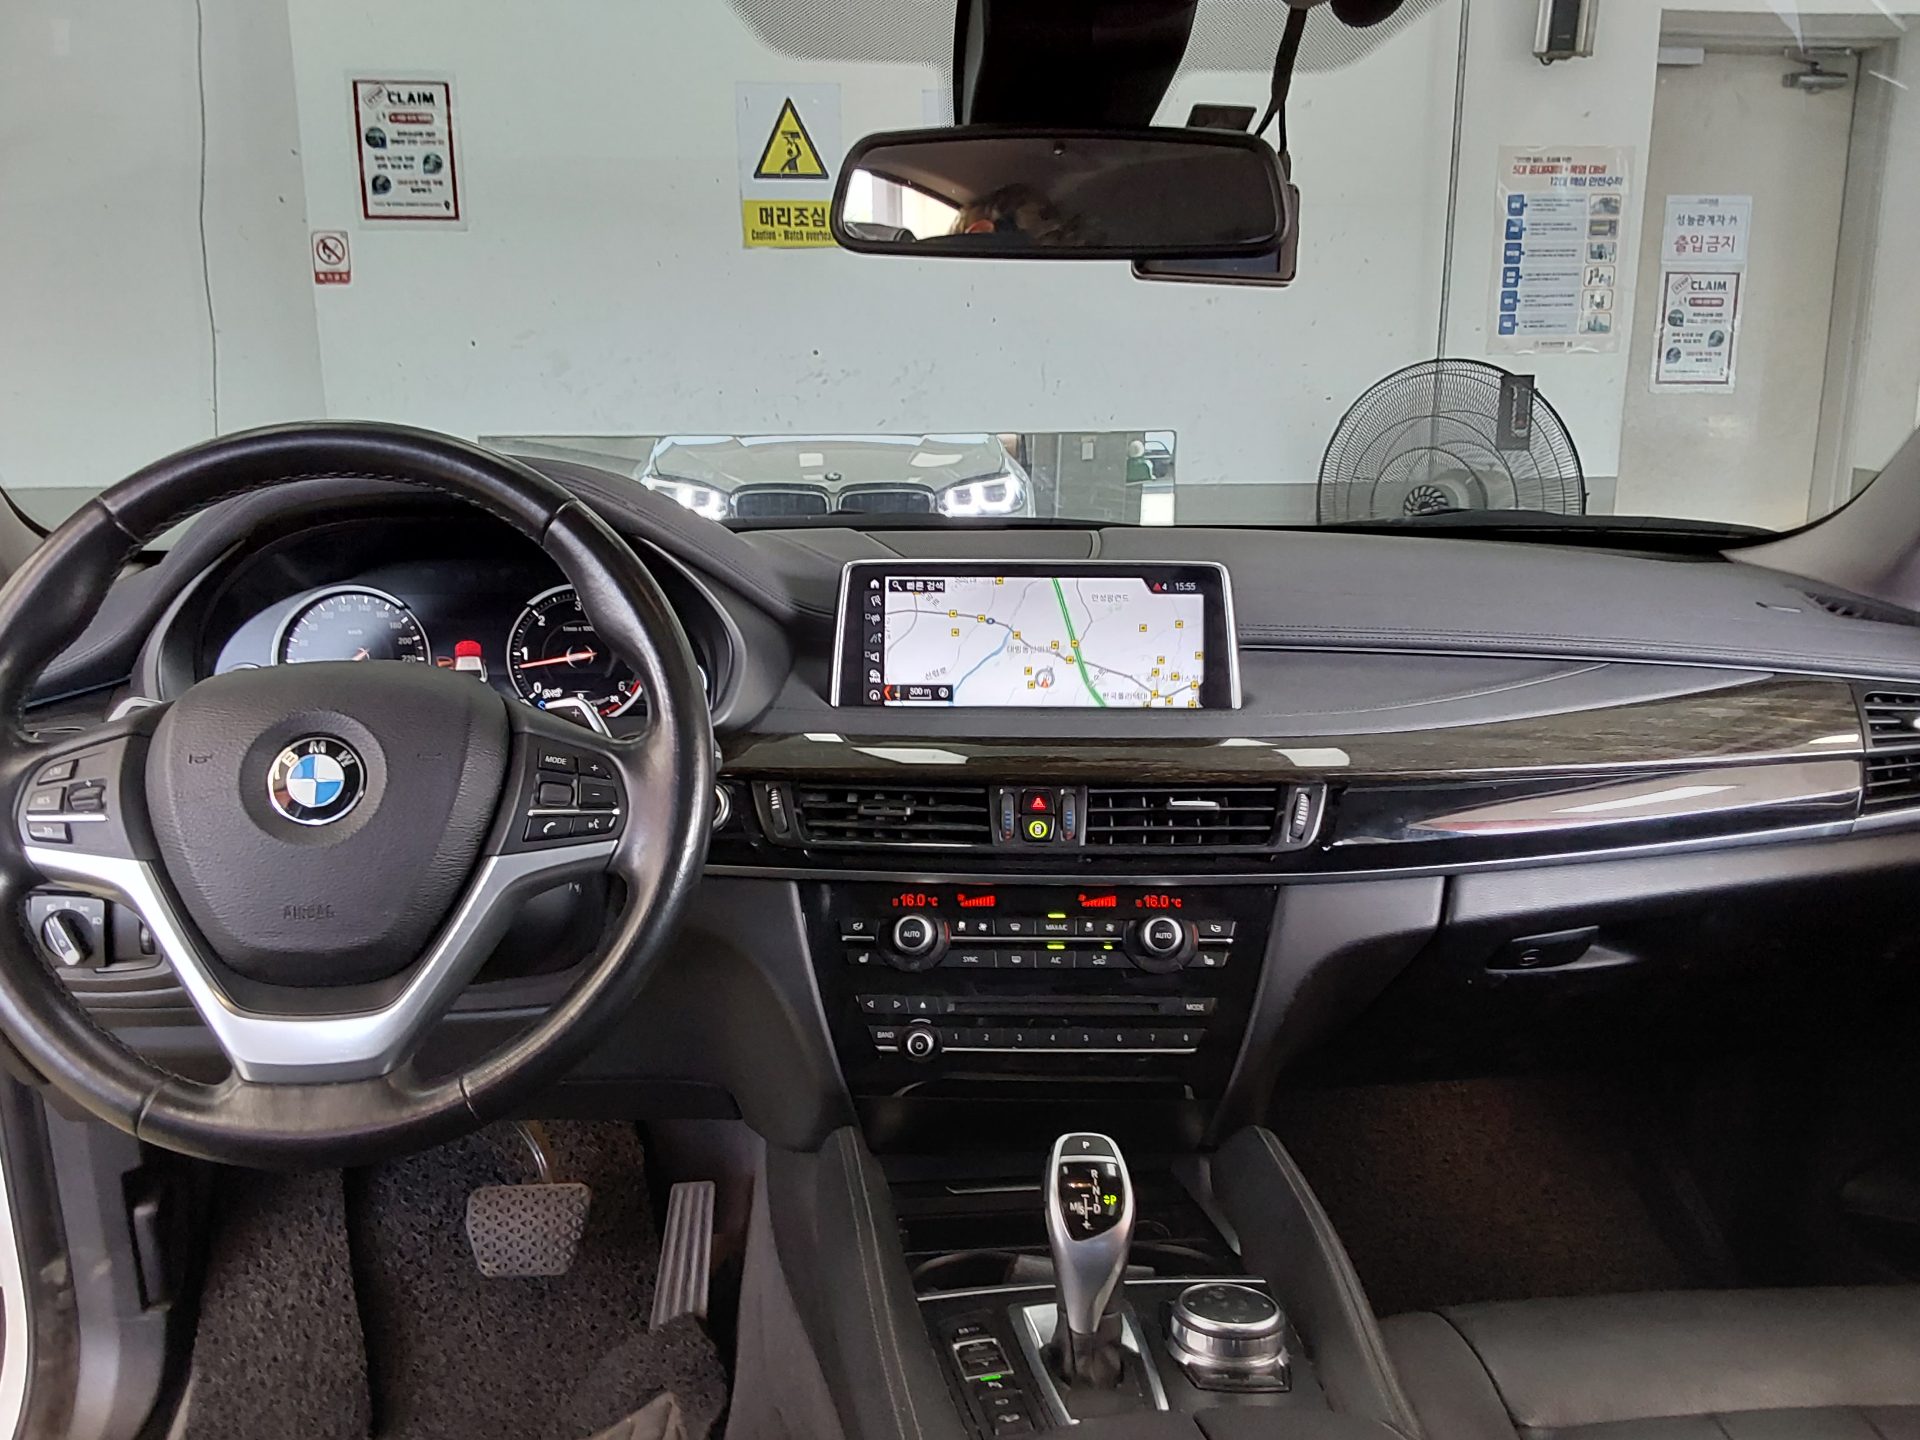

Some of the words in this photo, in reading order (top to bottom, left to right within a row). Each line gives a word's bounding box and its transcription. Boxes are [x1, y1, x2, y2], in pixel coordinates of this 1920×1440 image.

[387, 91, 435, 106] CLAIM
[1588, 176, 1623, 187] 안전수칙
[759, 206, 826, 228] 머리조심
[751, 229, 776, 241] Caution
[783, 229, 804, 241] Watch
[805, 229, 833, 241] overhea
[1673, 234, 1736, 256] 출입금지
[1690, 280, 1727, 291] CLAIM
[926, 580, 944, 591] 검색
[1175, 582, 1197, 591] 15:55
[574, 601, 582, 611] 3
[537, 615, 546, 627] 2
[398, 637, 412, 645] 200
[520, 646, 529, 661] 1
[533, 681, 542, 694] 0
[618, 680, 626, 692] 6
[281, 740, 356, 769] BMW
[544, 755, 568, 766] MODE
[900, 893, 926, 907] 16.0
[1143, 894, 1169, 908] 16.0
[903, 930, 921, 938] AUTO
[1155, 932, 1173, 940] AUTO
[962, 955, 979, 963] SYNC
[1185, 1003, 1205, 1012] MODE
[876, 1031, 895, 1039] BAND
[954, 1033, 959, 1041] 1
[983, 1033, 990, 1041] 2
[1016, 1033, 1023, 1041] 3
[1050, 1033, 1056, 1041] 4
[1082, 1140, 1090, 1149] P
[1090, 1168, 1099, 1179] R
[1092, 1185, 1101, 1196] N
[1109, 1195, 1117, 1205] P
[1093, 1203, 1101, 1214] D
